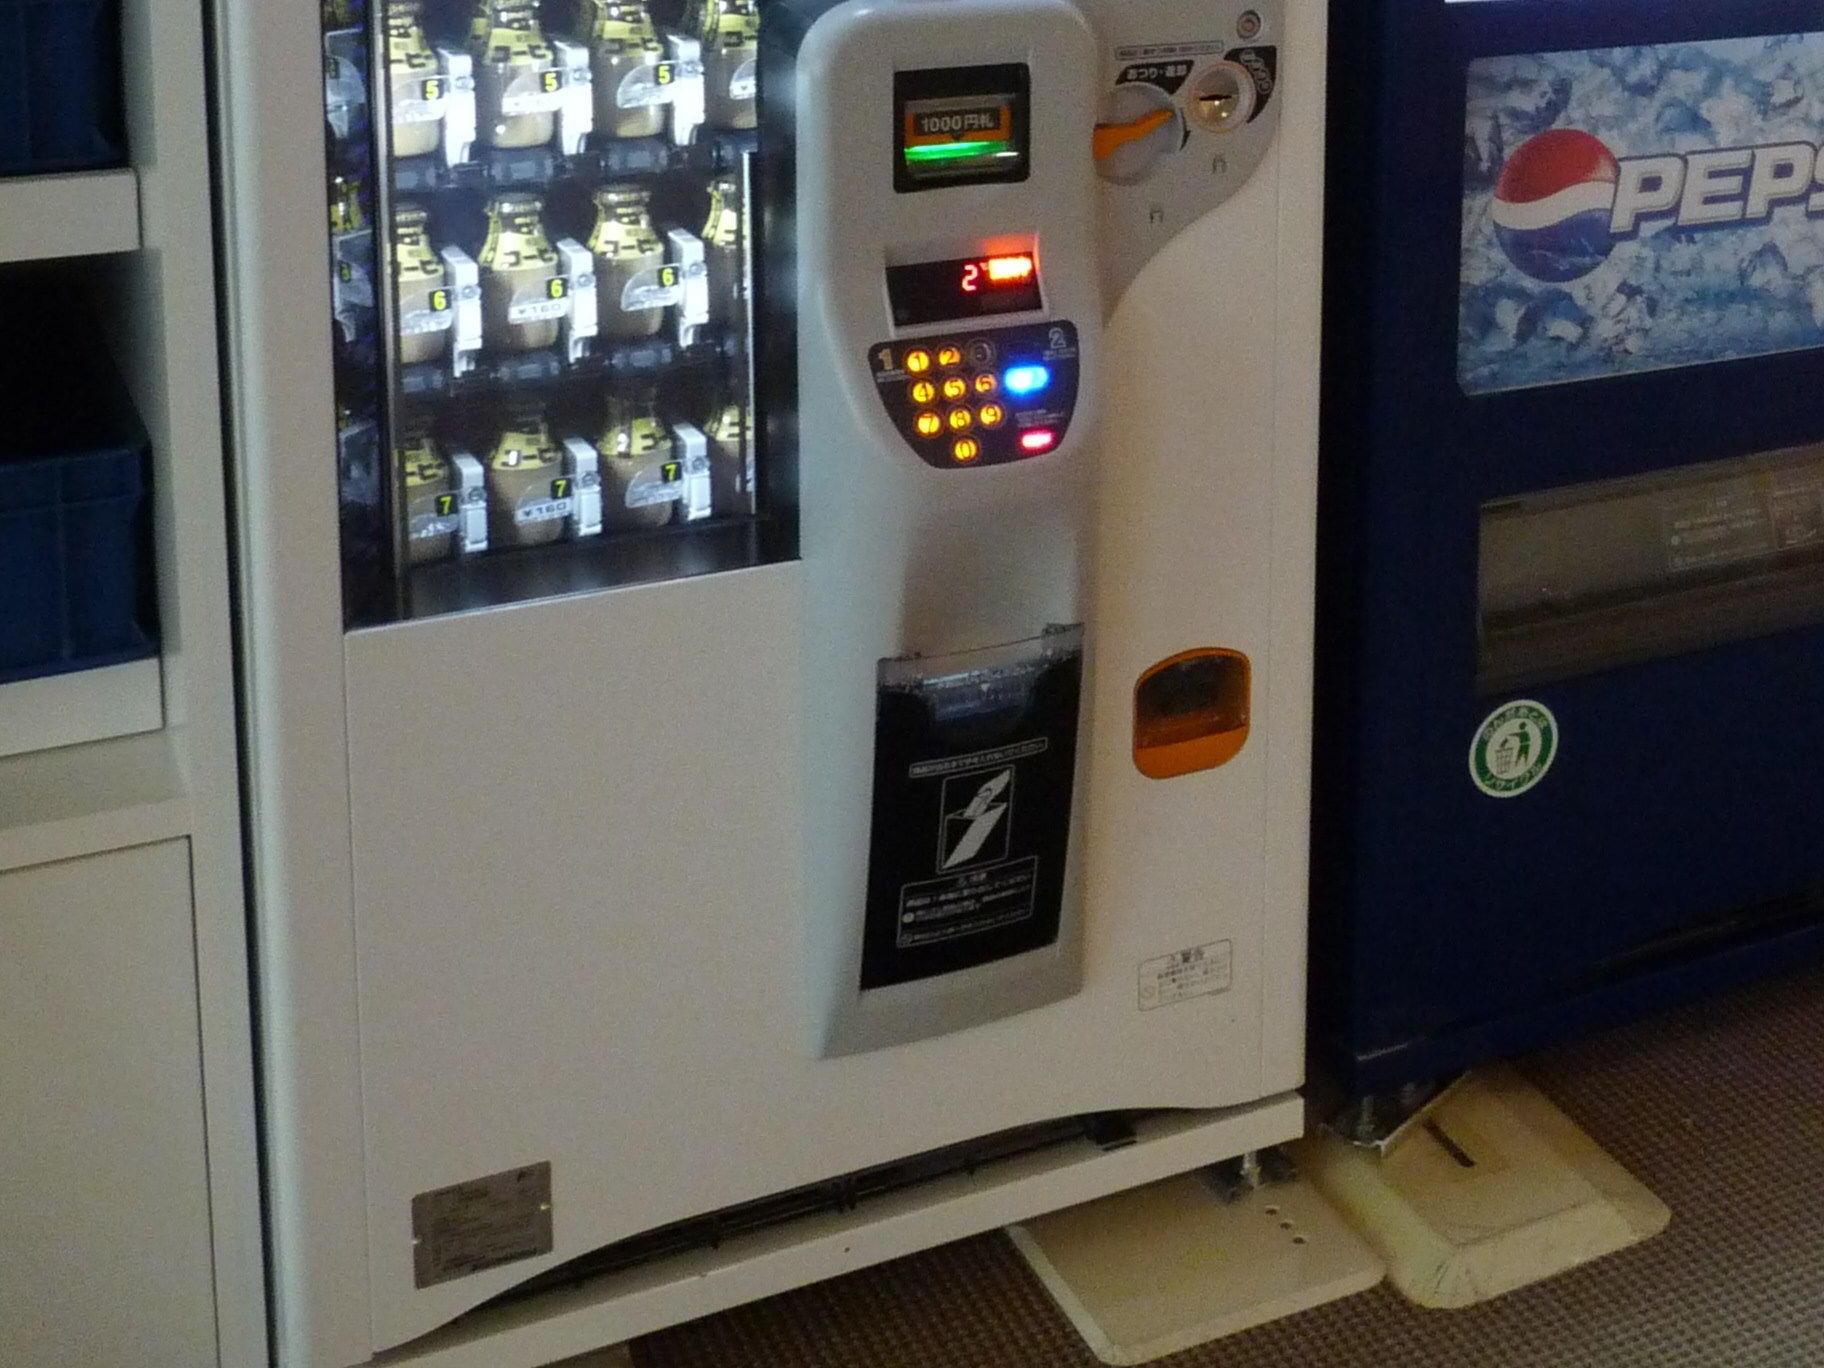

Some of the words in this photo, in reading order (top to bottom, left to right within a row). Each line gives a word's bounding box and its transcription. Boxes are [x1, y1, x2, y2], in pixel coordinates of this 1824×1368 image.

[543, 72, 557, 92] 5
[657, 64, 670, 83] 5
[425, 80, 438, 100] 5
[921, 114, 995, 132] 1000円札
[660, 268, 673, 287] 6
[961, 263, 978, 292] 2
[549, 279, 563, 298] 6
[432, 290, 446, 311] 6
[665, 463, 677, 482] 7
[555, 479, 568, 498] 7
[440, 495, 453, 514] 7
[523, 502, 567, 517] ¥160
